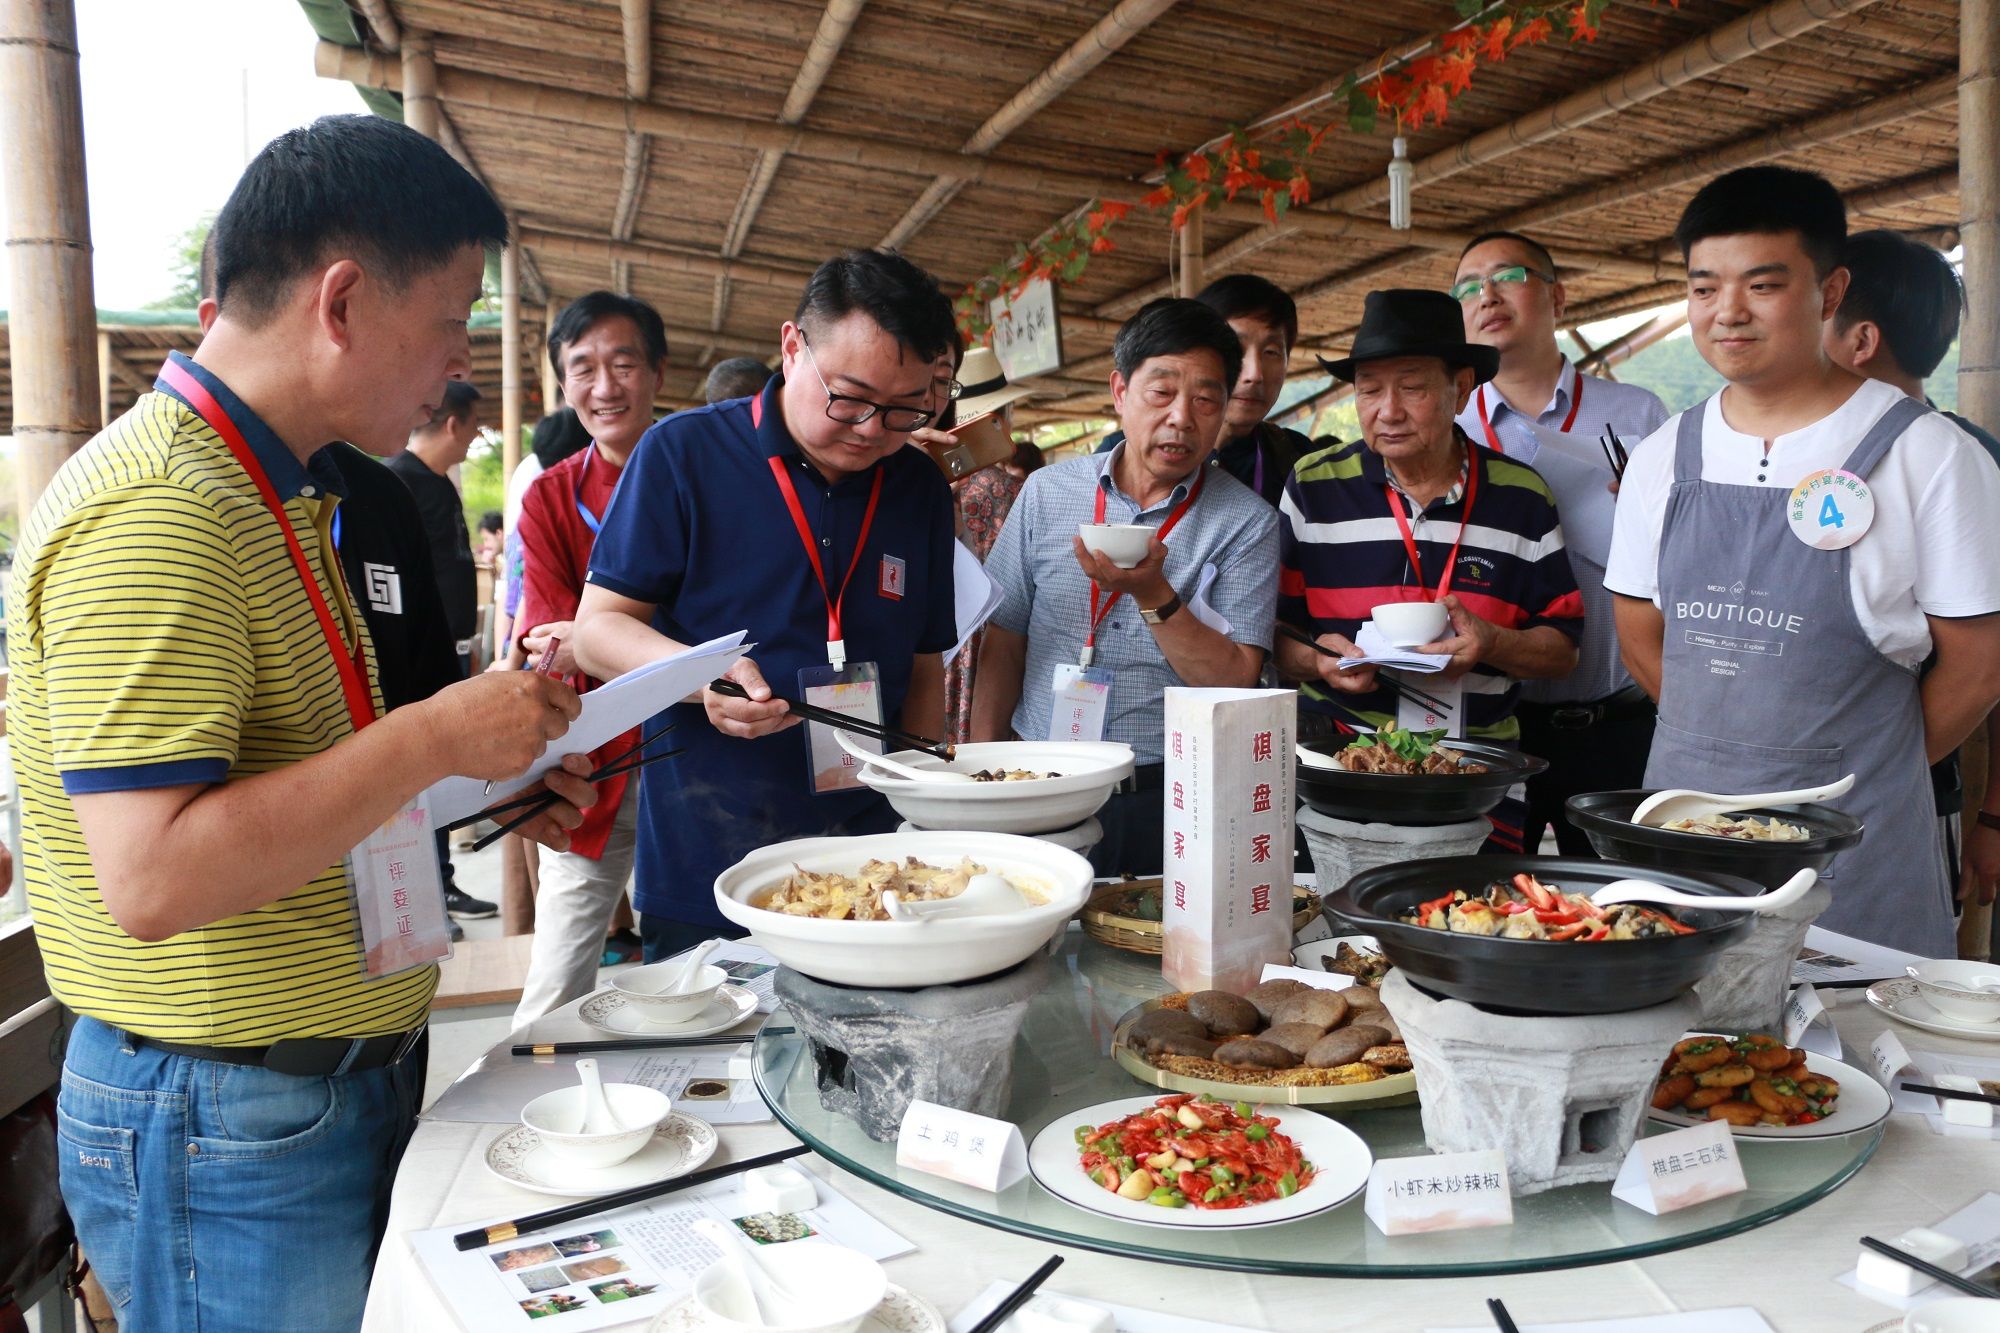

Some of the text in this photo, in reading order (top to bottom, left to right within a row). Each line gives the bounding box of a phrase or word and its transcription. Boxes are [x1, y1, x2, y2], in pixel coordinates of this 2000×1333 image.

[1792, 475, 1867, 521] 临安乡村宴席展示
[1819, 493, 1845, 529] 4
[1707, 584, 1726, 593] MEZO
[1676, 602, 1804, 634] BOUTIQUE
[1710, 659, 1740, 669] ORIGINAL
[1711, 667, 1736, 677] DESIGN
[1252, 731, 1272, 915] 棋盘家宴
[389, 861, 413, 936] 评委证
[917, 1123, 985, 1154] 土鸡煲
[1652, 1143, 1729, 1177] 棋盘三石煲
[1387, 1172, 1501, 1198] 小虾米炒辣椒
